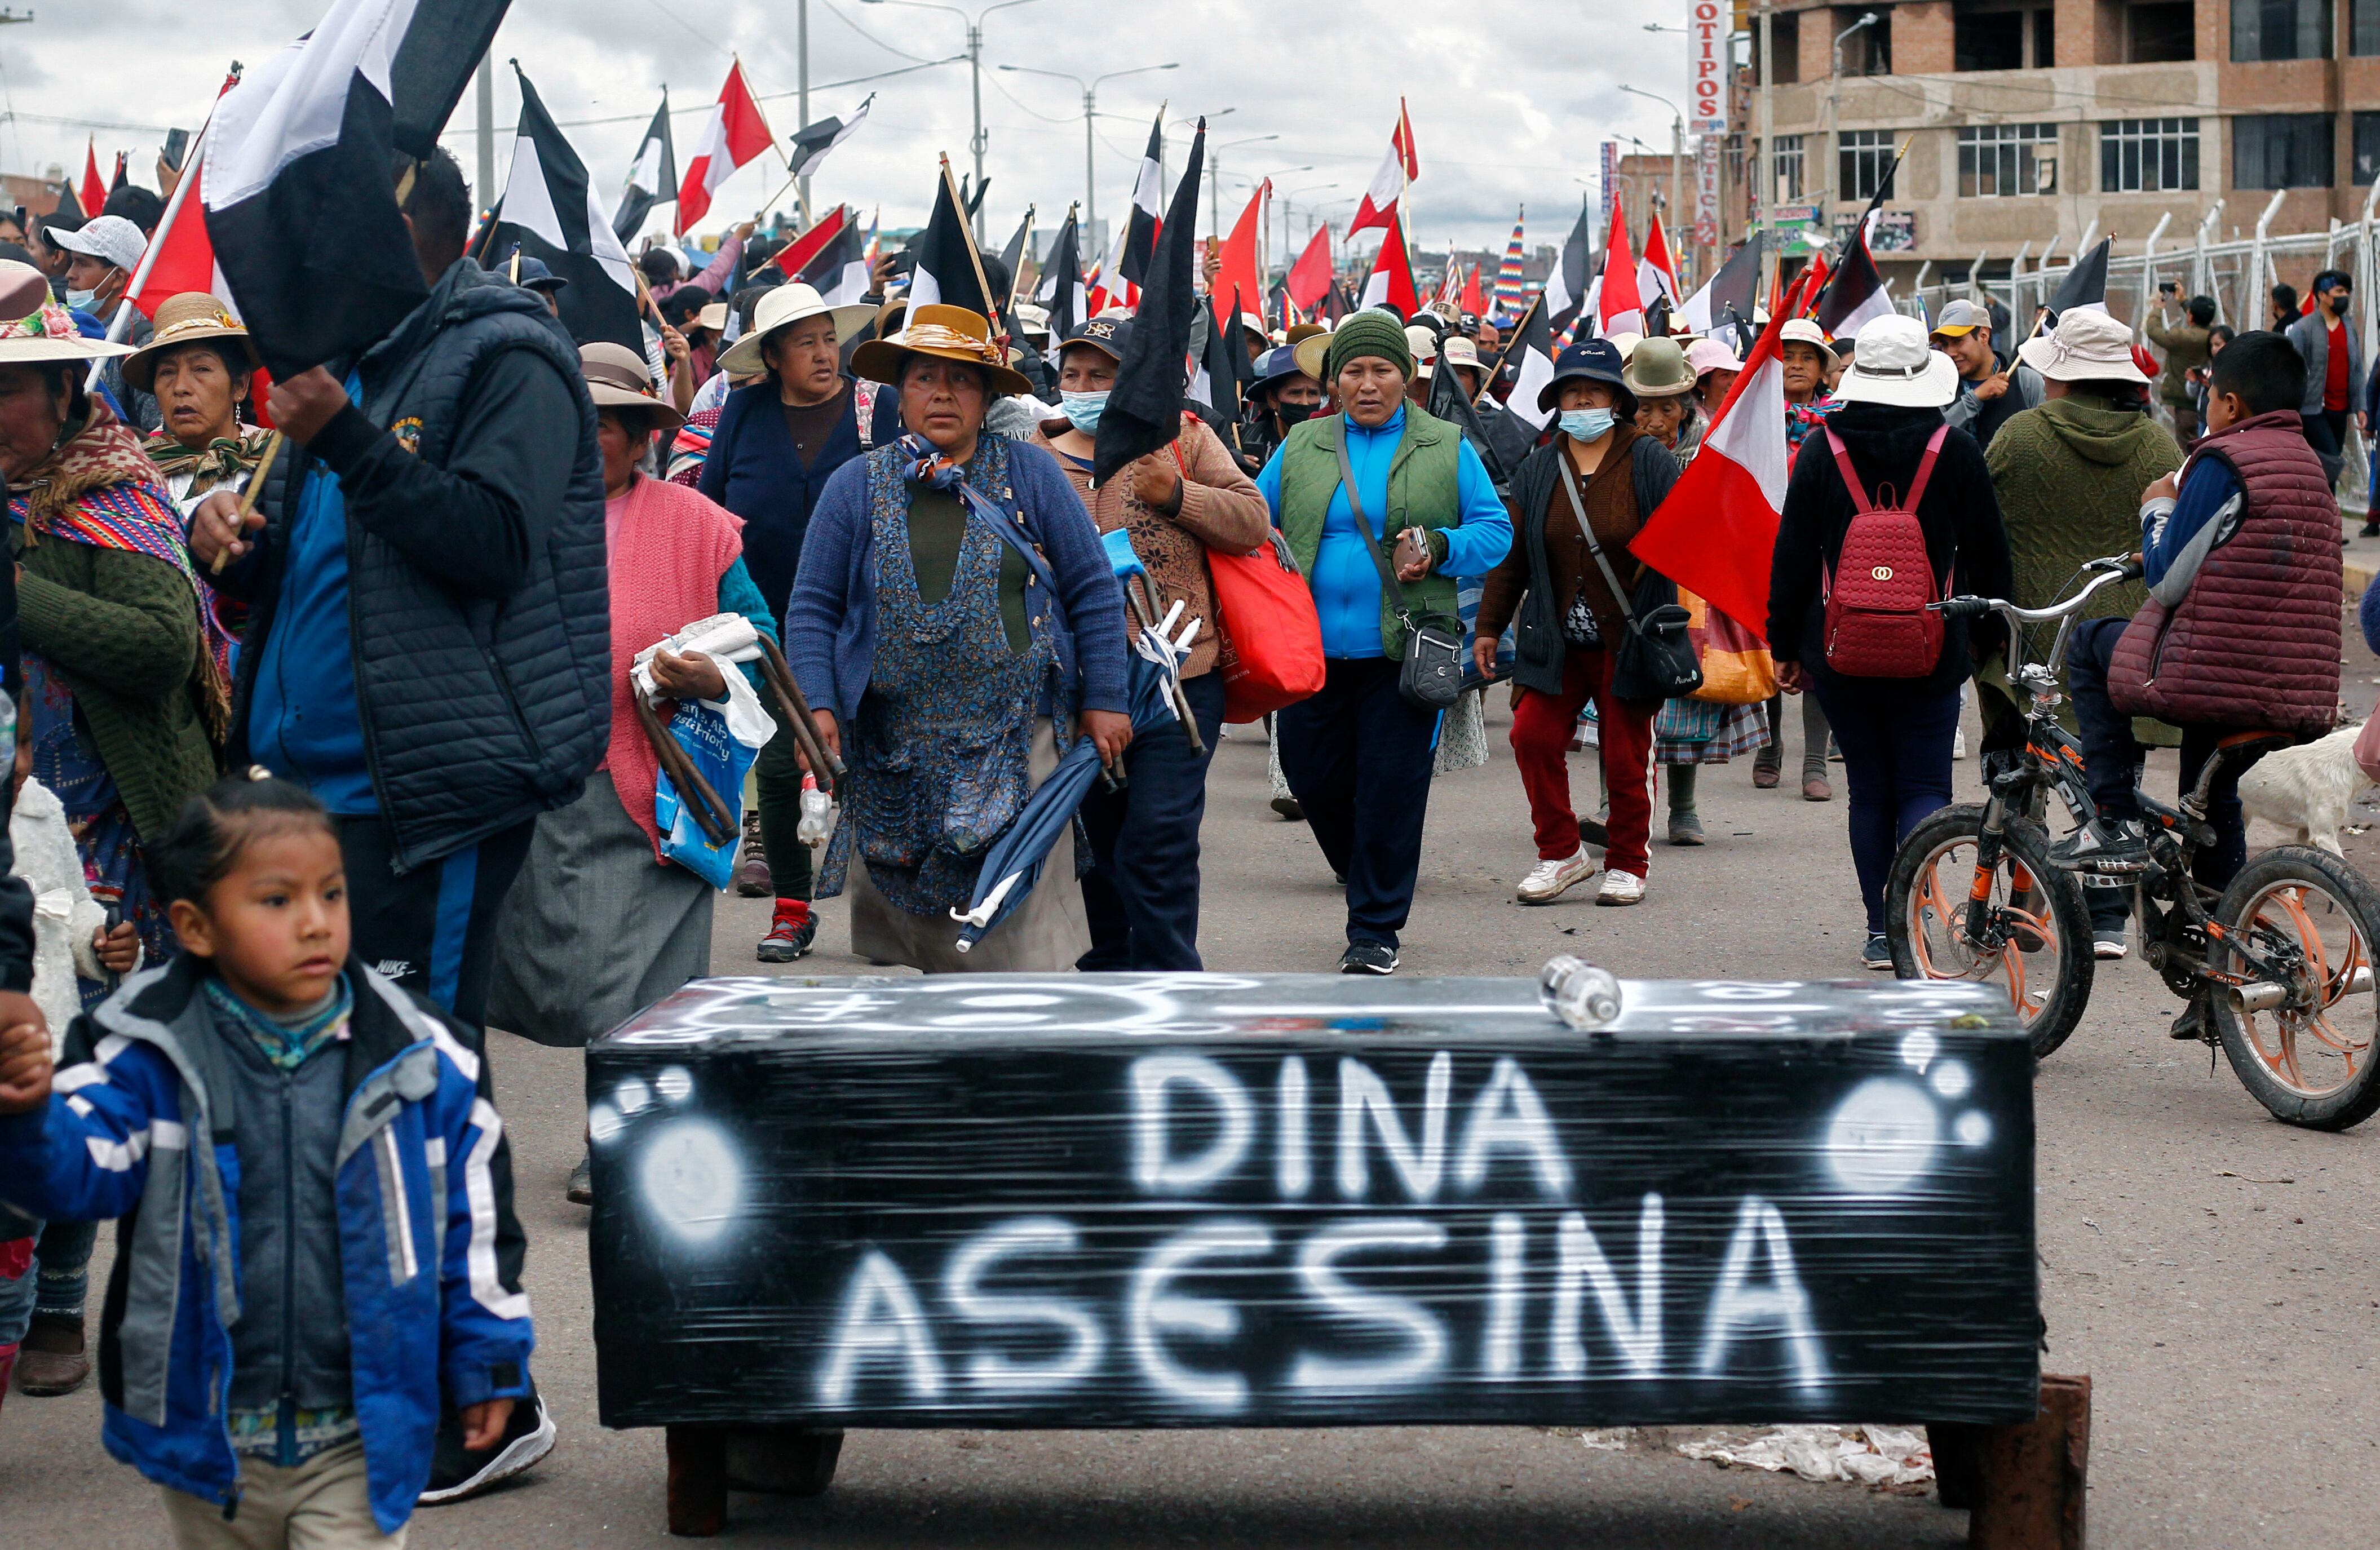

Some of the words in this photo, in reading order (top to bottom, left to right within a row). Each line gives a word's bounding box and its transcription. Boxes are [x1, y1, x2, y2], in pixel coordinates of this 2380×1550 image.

[1696, 0, 1718, 117] OTIPOS
[374, 959, 410, 974] NIKE
[1127, 1049, 1576, 1198] DINA
[815, 1190, 1829, 1409] ASESINA
